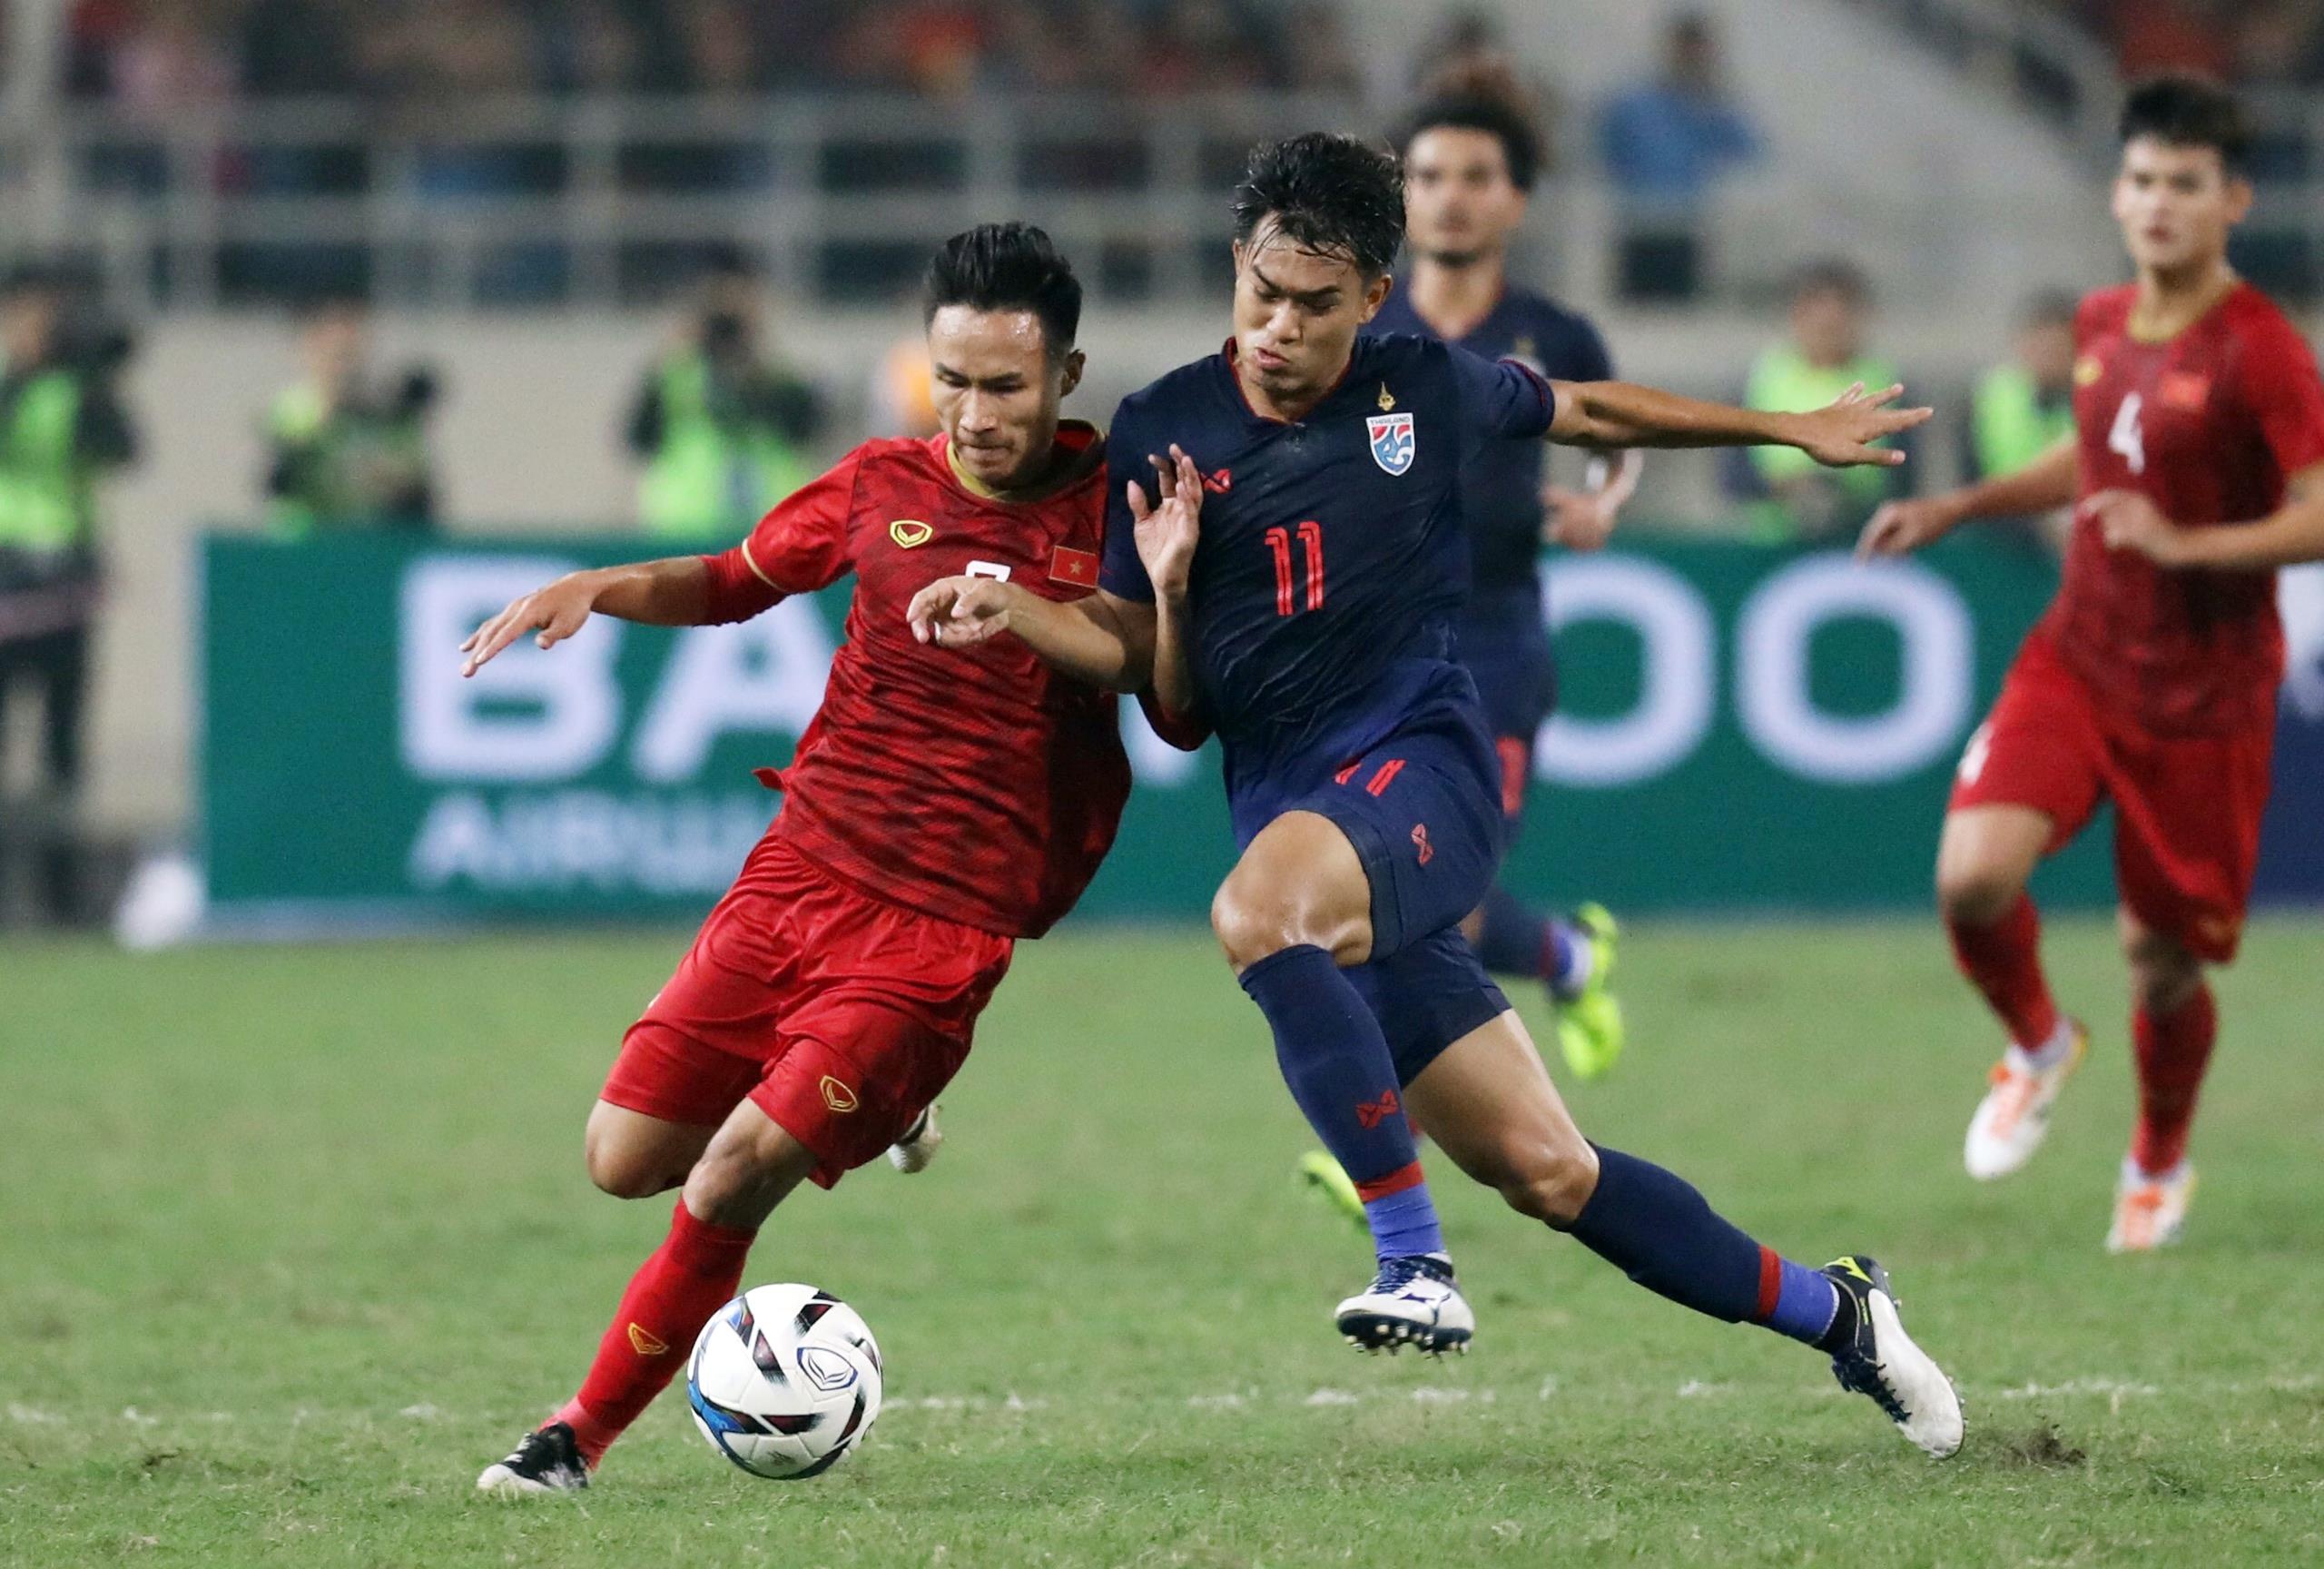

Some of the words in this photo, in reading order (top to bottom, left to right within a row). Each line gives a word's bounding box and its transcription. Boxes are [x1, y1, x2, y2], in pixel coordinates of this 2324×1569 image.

[1370, 416, 1410, 425] THAILAND
[2108, 390, 2145, 475] 4
[1265, 520, 1324, 617] 11
